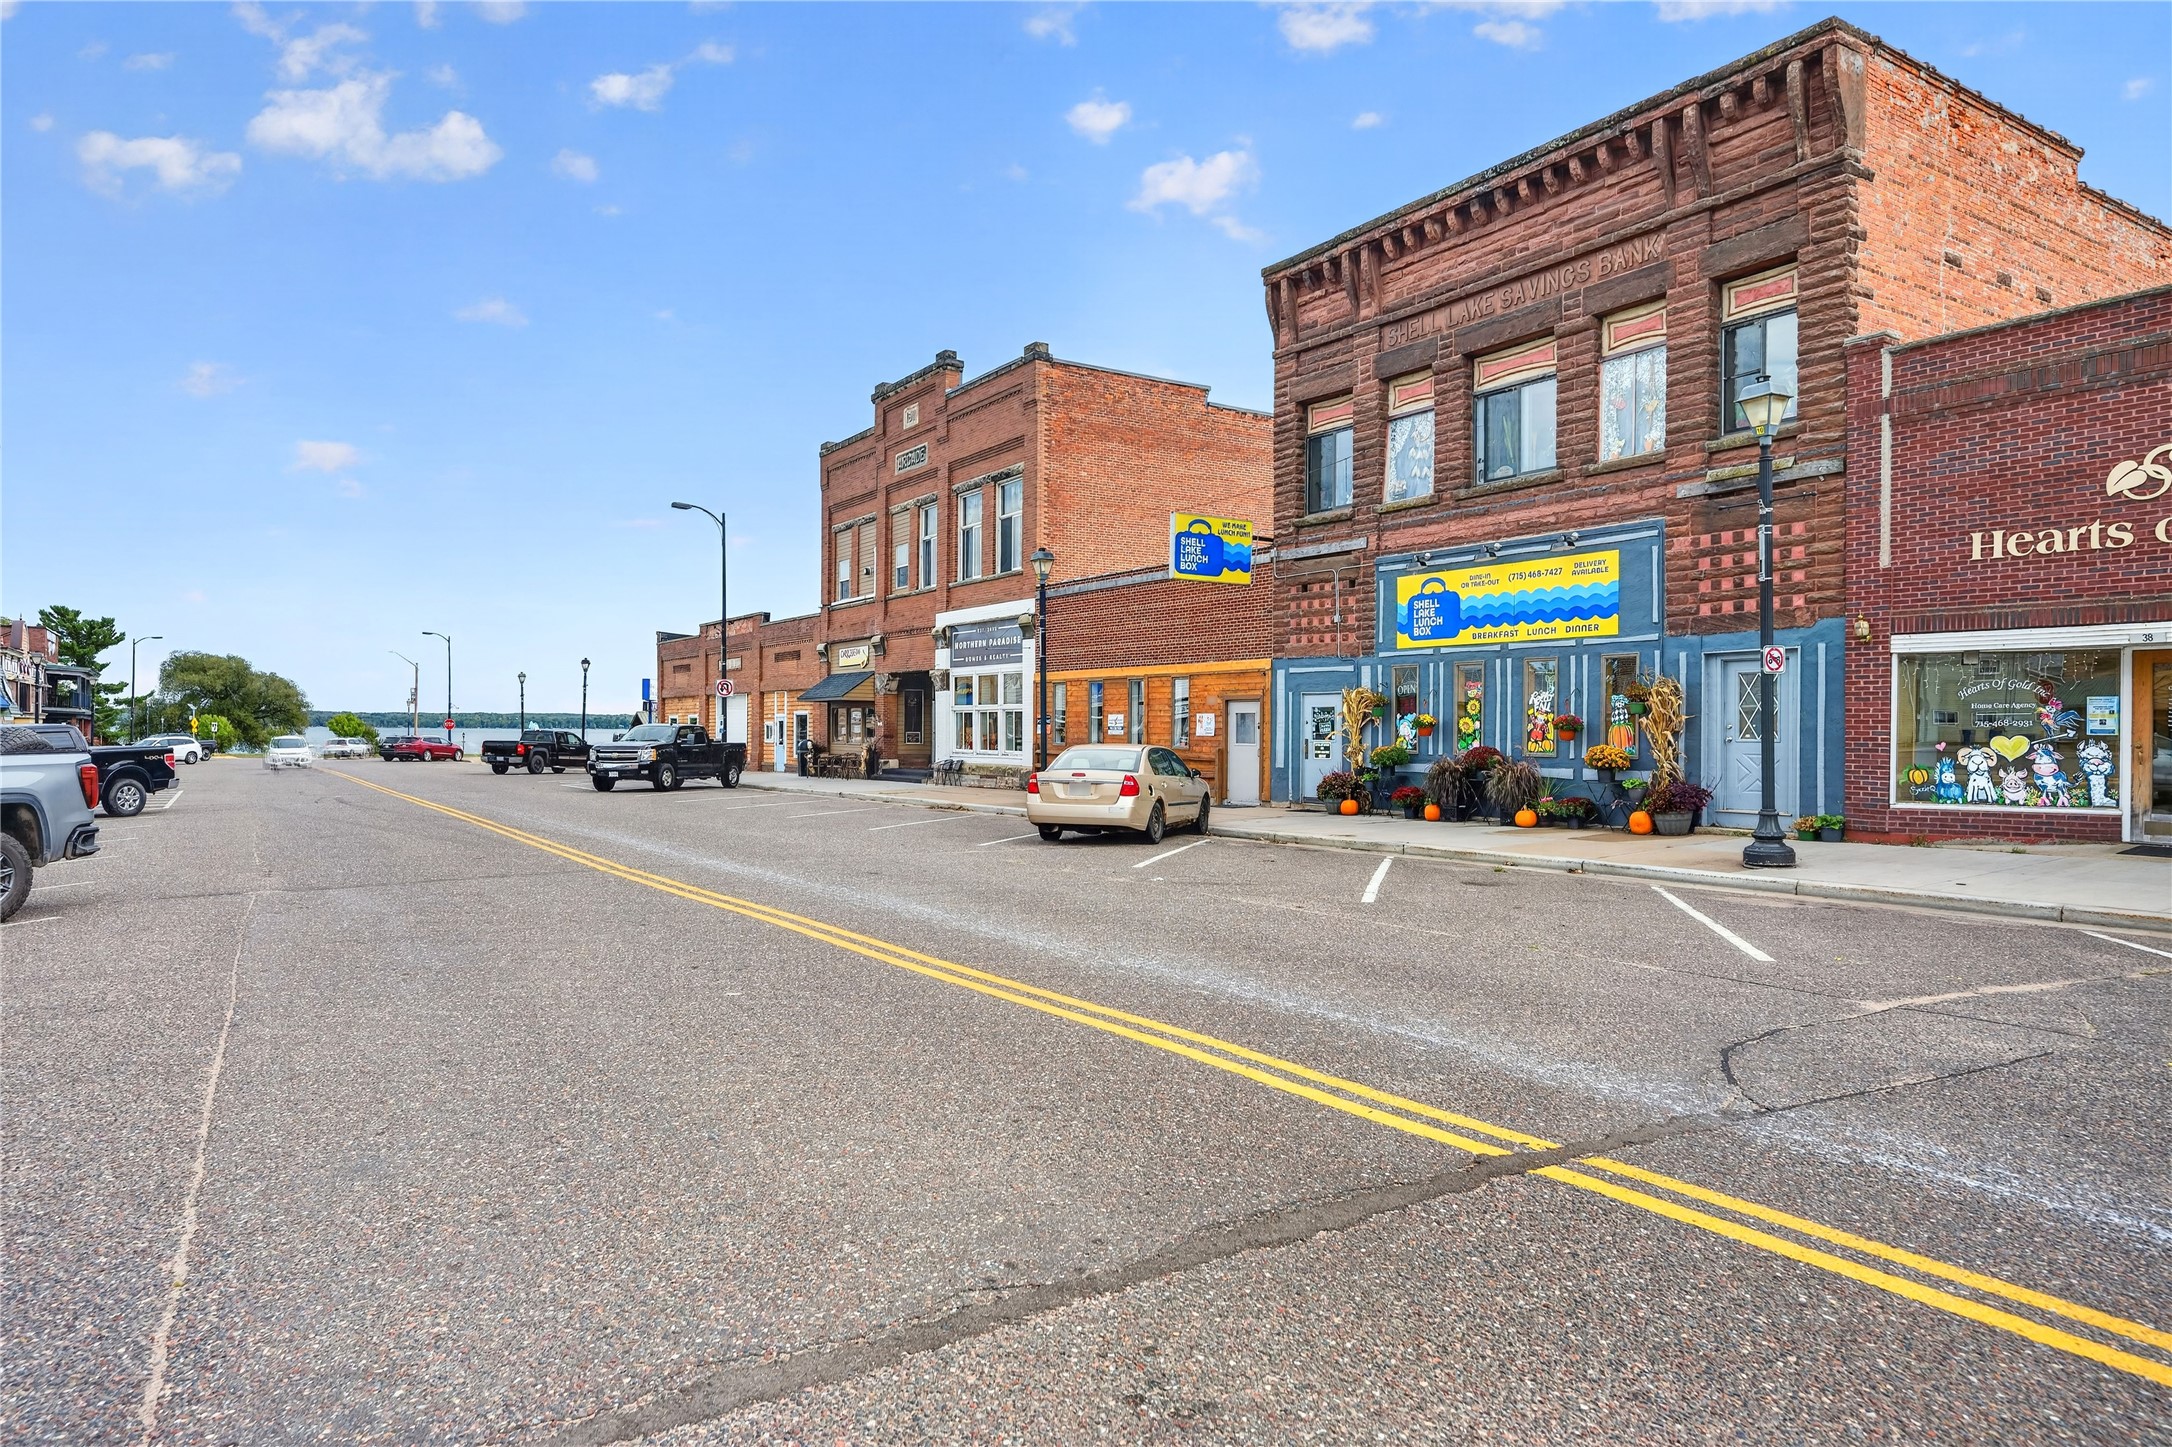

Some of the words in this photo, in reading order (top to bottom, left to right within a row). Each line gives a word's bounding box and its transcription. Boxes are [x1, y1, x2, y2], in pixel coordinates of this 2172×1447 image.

[1388, 313, 1441, 347] SHELL
[1447, 292, 1495, 328] LAKE
[1500, 260, 1591, 309] SAVINGS
[1599, 234, 1662, 278] BANK
[897, 446, 927, 471] ARCADE
[1180, 536, 1206, 547] SHELL
[1970, 518, 2135, 561] Hearts
[1180, 545, 1202, 555] LAKE
[1180, 554, 1209, 564] LUNCH
[1573, 559, 1607, 569] DELIVERY
[1180, 562, 1198, 571] BOX
[1571, 566, 1609, 576] AVAILABLE
[1469, 573, 1491, 581] DINE-IN
[1508, 571, 1527, 583] (715)
[1528, 568, 1563, 579] 468-7427
[1471, 579, 1500, 588] TAKE-OUT
[1413, 598, 1440, 610] SHELL
[1413, 608, 1436, 619] LAKE
[1413, 616, 1444, 628] LUNCH
[1413, 626, 1432, 637] BOX
[1472, 630, 1519, 640] BREAKFAST
[1526, 627, 1557, 636] LUNCH
[1565, 623, 1600, 633] DINNER
[954, 639, 987, 650] NORTHERN
[988, 635, 1021, 647] PARADISE
[2142, 633, 2154, 642] 38
[1397, 684, 1416, 696] OPEN
[1957, 681, 1990, 701] Hearts
[1991, 677, 2008, 691] Of
[2007, 679, 2036, 690] Gold
[2011, 702, 2036, 710] Agency
[1975, 719, 2034, 728] 715-468-2931
